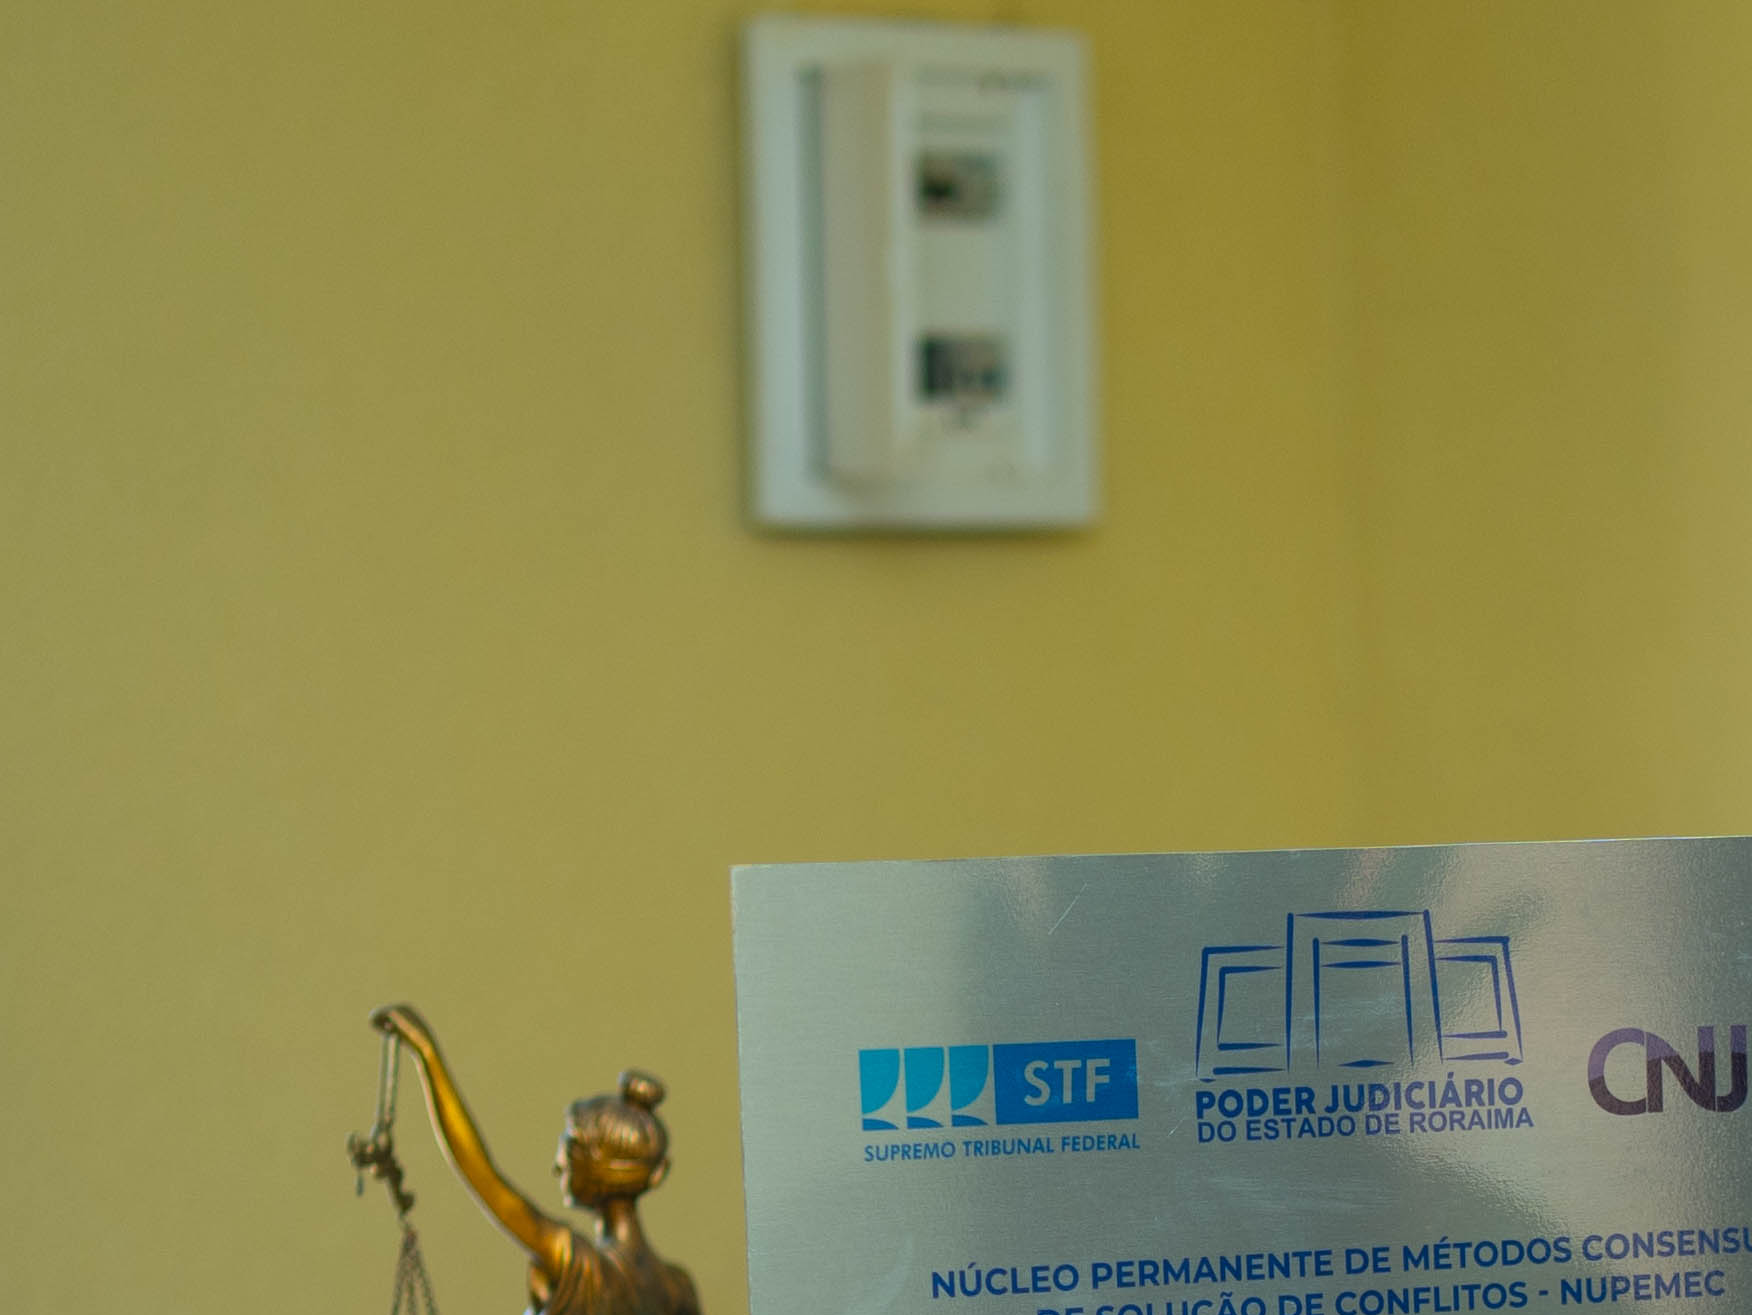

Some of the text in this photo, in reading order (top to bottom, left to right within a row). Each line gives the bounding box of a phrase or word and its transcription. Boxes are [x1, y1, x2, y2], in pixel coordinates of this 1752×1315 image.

[1023, 1057, 1111, 1107] STF
[1587, 1023, 1748, 1116] CNJ
[1196, 1071, 1524, 1120] PODER JUDICIÁRIO
[863, 1132, 1141, 1162] SUPREMO TRIBUNAL FEDERAL
[1197, 1106, 1535, 1144] DO ESTADO DE RORAIMA
[931, 1261, 1080, 1299] NÚCLEO
[1091, 1248, 1334, 1290] PERMANENTE
[1345, 1244, 1392, 1275] DE
[1402, 1236, 1573, 1272] MÉTODOS
[1560, 1269, 1726, 1306] NUPEMEC
